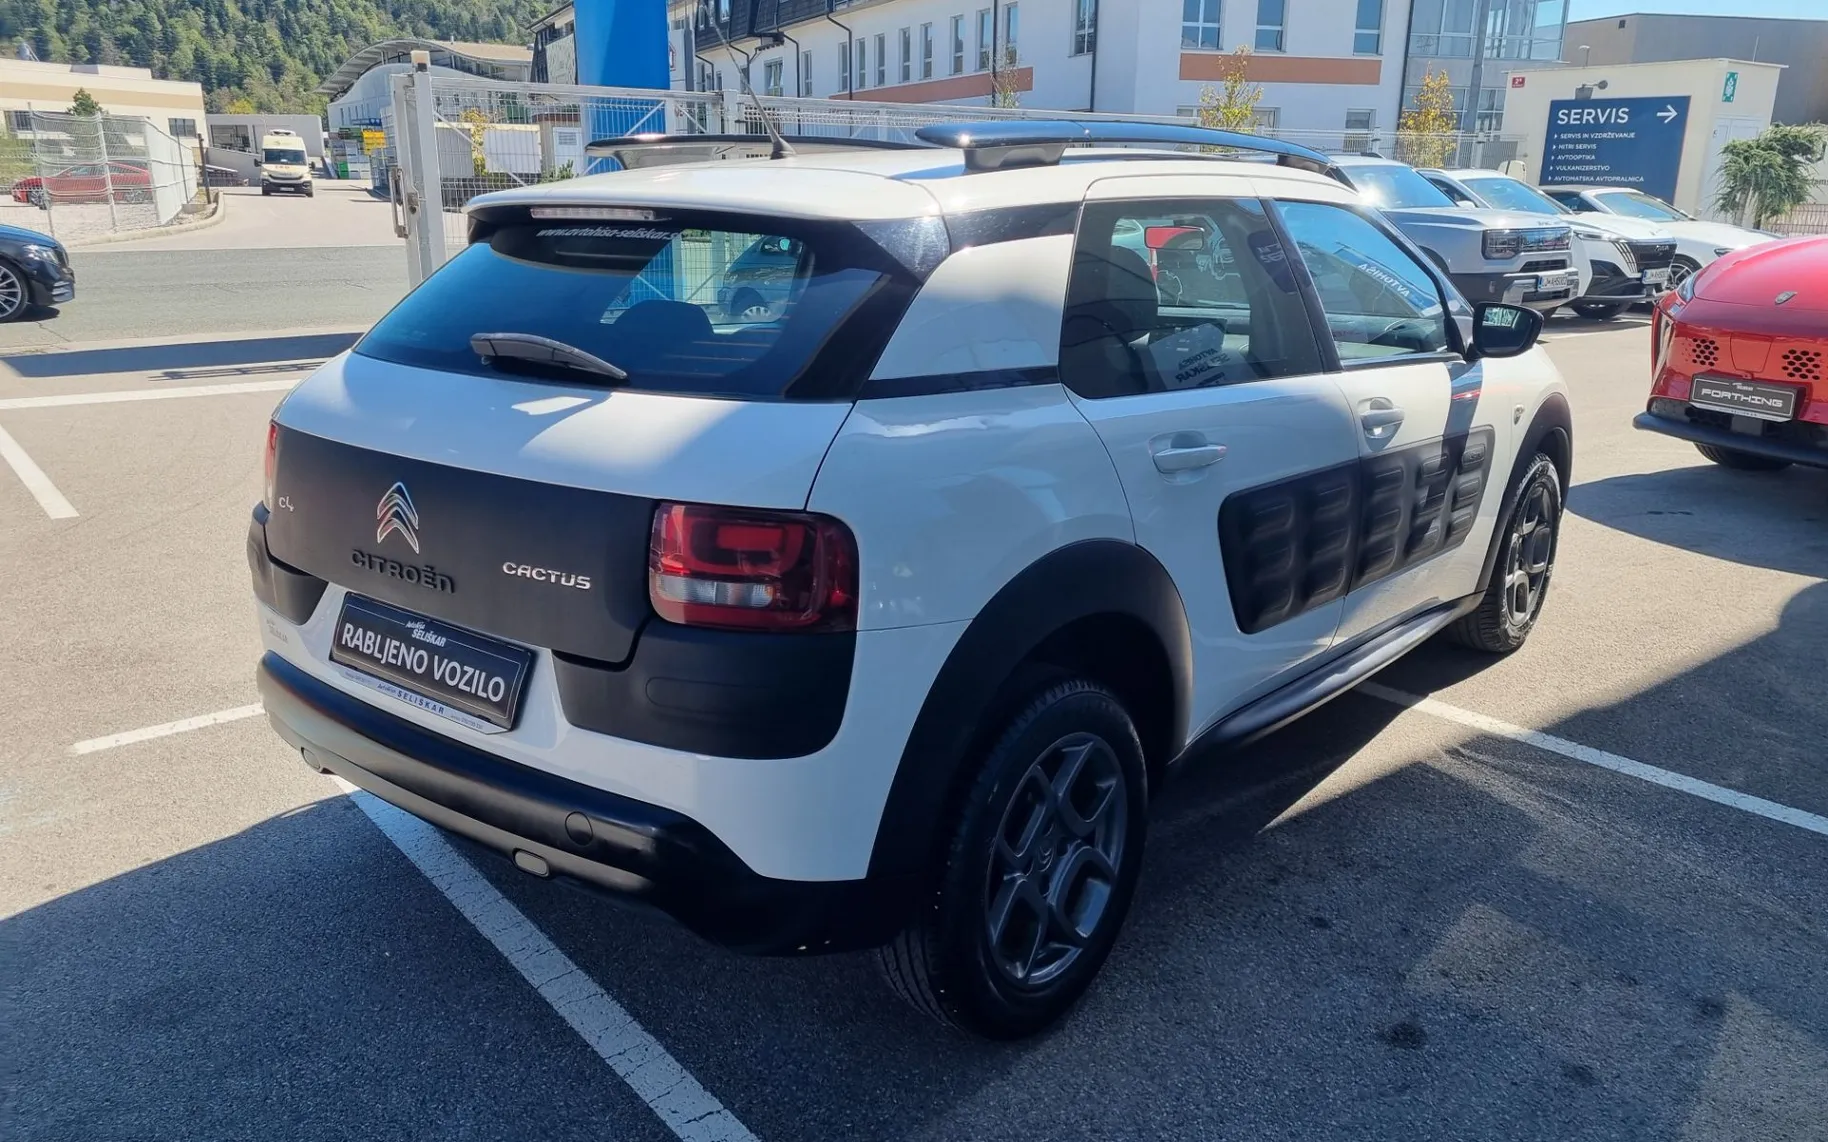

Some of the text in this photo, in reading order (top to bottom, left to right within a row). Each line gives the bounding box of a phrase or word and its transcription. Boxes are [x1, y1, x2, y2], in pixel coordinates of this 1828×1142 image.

[1557, 107, 1630, 125] SERVIS
[1590, 131, 1636, 139] VZDRŽEVANJE
[1701, 388, 1784, 408] FORTHING
[278, 496, 295, 511] C4
[350, 548, 456, 593] CITROËN
[502, 561, 591, 590] CACTUS
[411, 628, 447, 648] SELIŠKAR
[341, 622, 429, 675] RABLJENO
[433, 654, 506, 703] VOZILO
